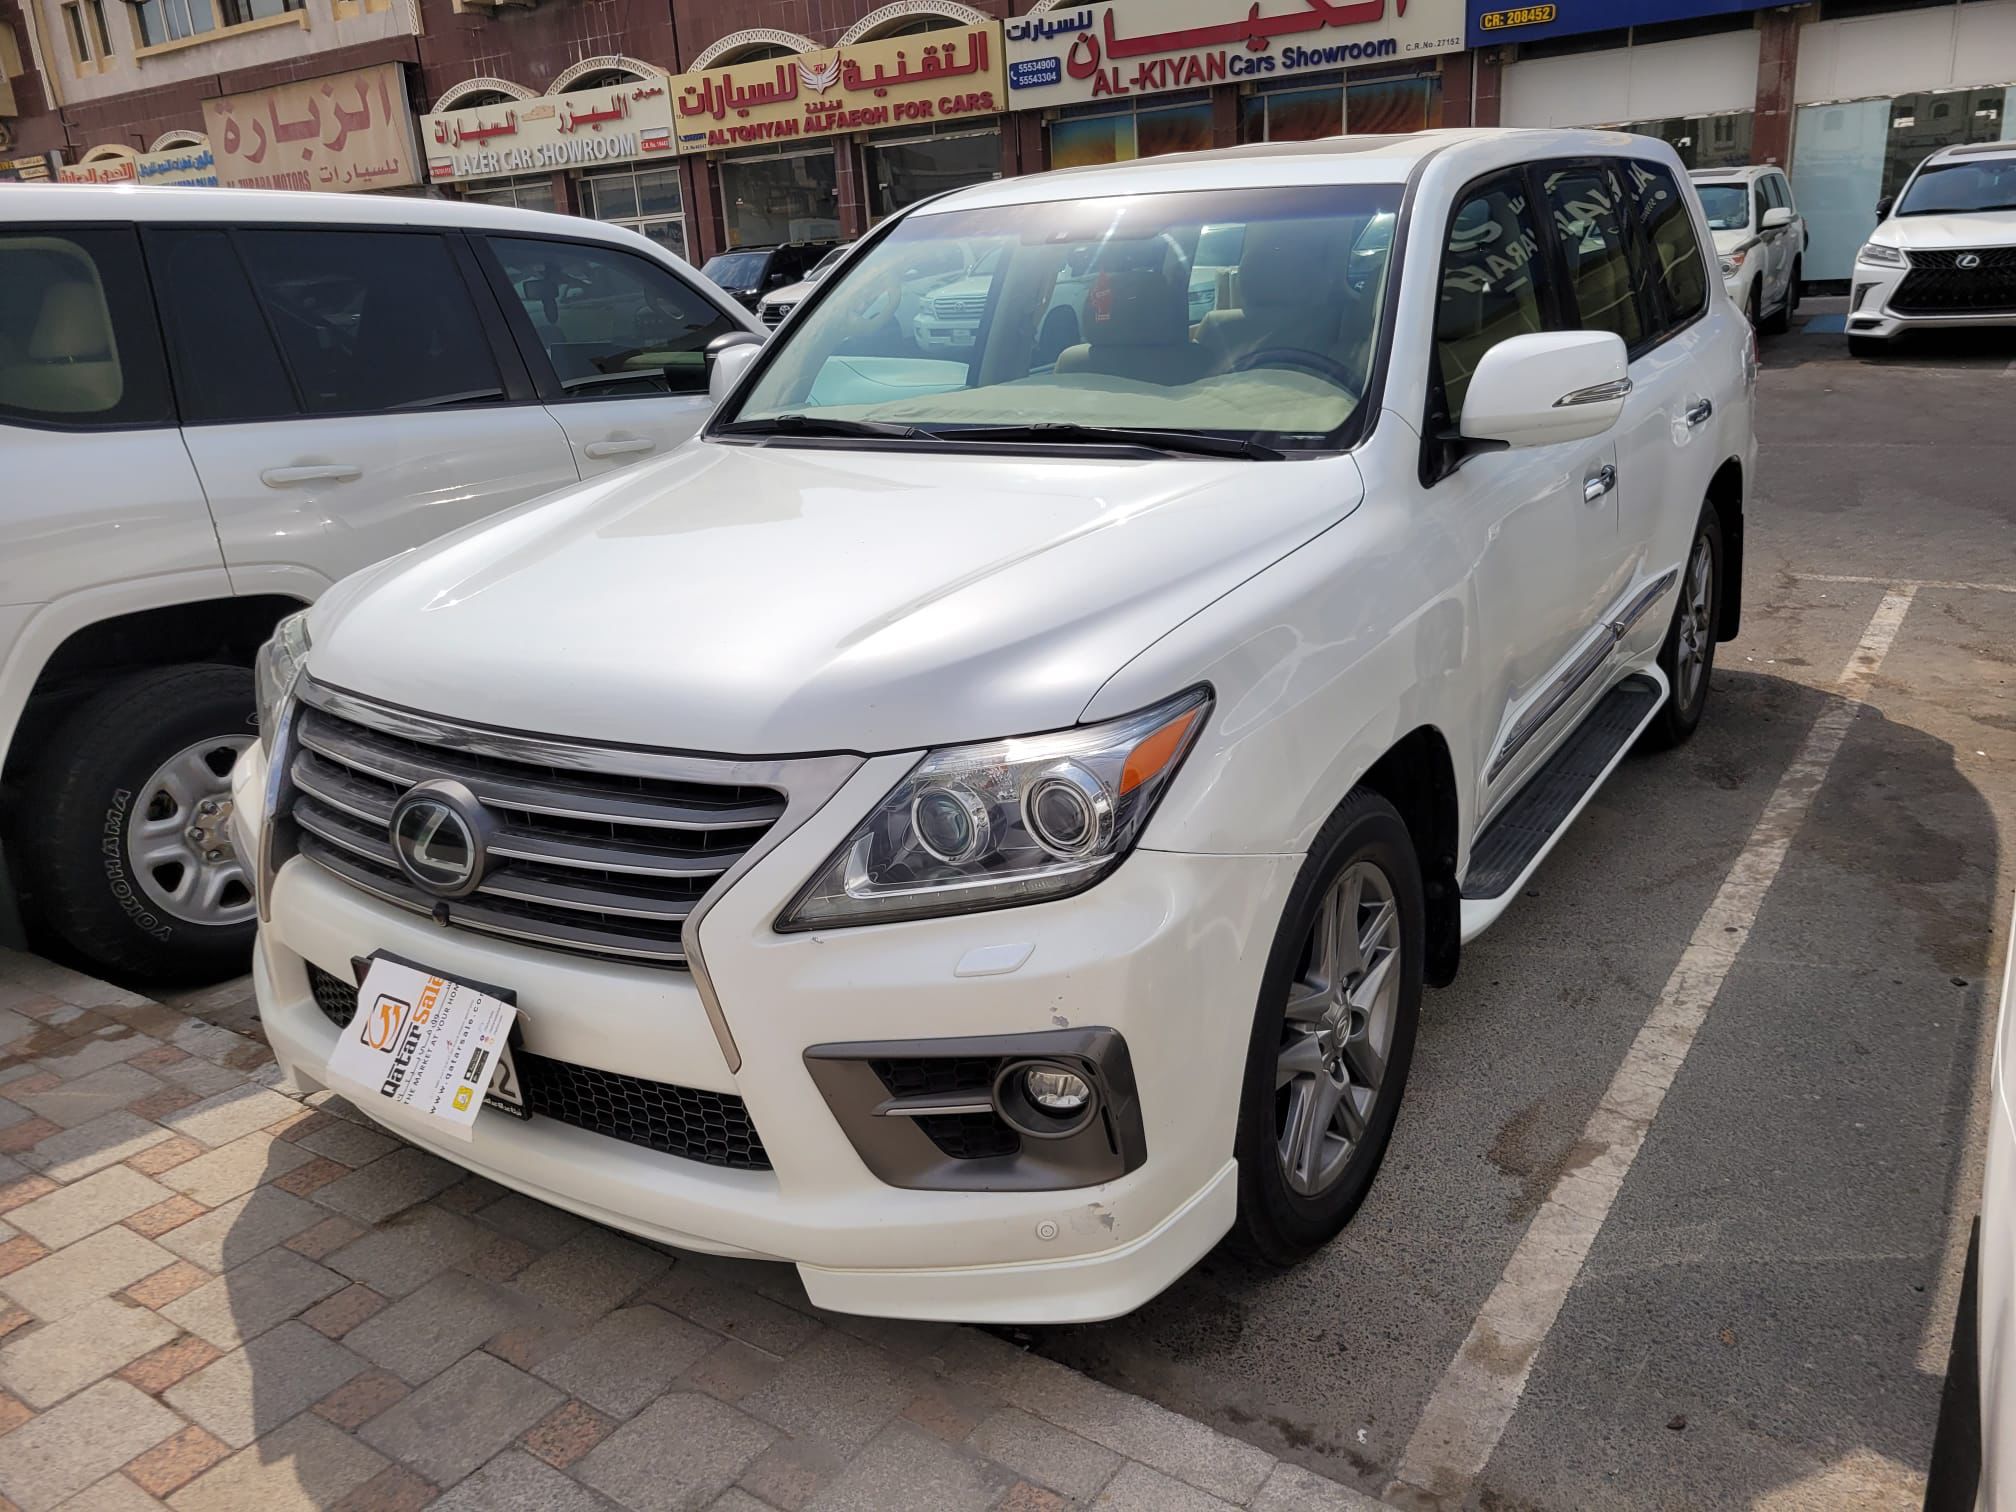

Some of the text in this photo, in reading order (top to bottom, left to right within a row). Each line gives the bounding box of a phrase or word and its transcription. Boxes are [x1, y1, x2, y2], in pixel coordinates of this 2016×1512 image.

[1006, 10, 1093, 42] للسيارات
[1484, 7, 1550, 28] CR: 208452
[843, 30, 989, 98] التقنية
[1018, 59, 1056, 74] 55534900
[1019, 72, 1057, 86] 55543304
[1091, 38, 1397, 97] AL-KIYAN Cars Showroom
[678, 63, 799, 120] للسيارات
[803, 105, 889, 133] ALFAEQH
[893, 100, 934, 121] FOR
[938, 91, 994, 115] CARS
[215, 70, 392, 164] الزبارة
[319, 158, 399, 183] للسيارات
[453, 151, 501, 176] LAZER
[503, 148, 534, 170] CAR
[535, 133, 637, 166] SHOWROOM
[102, 788, 173, 942] YOKOHAMA
[403, 1088, 416, 1105] THE
[413, 1048, 433, 1087] MARKET
[431, 1034, 440, 1047] AT
[436, 1007, 451, 1032] YOUR
